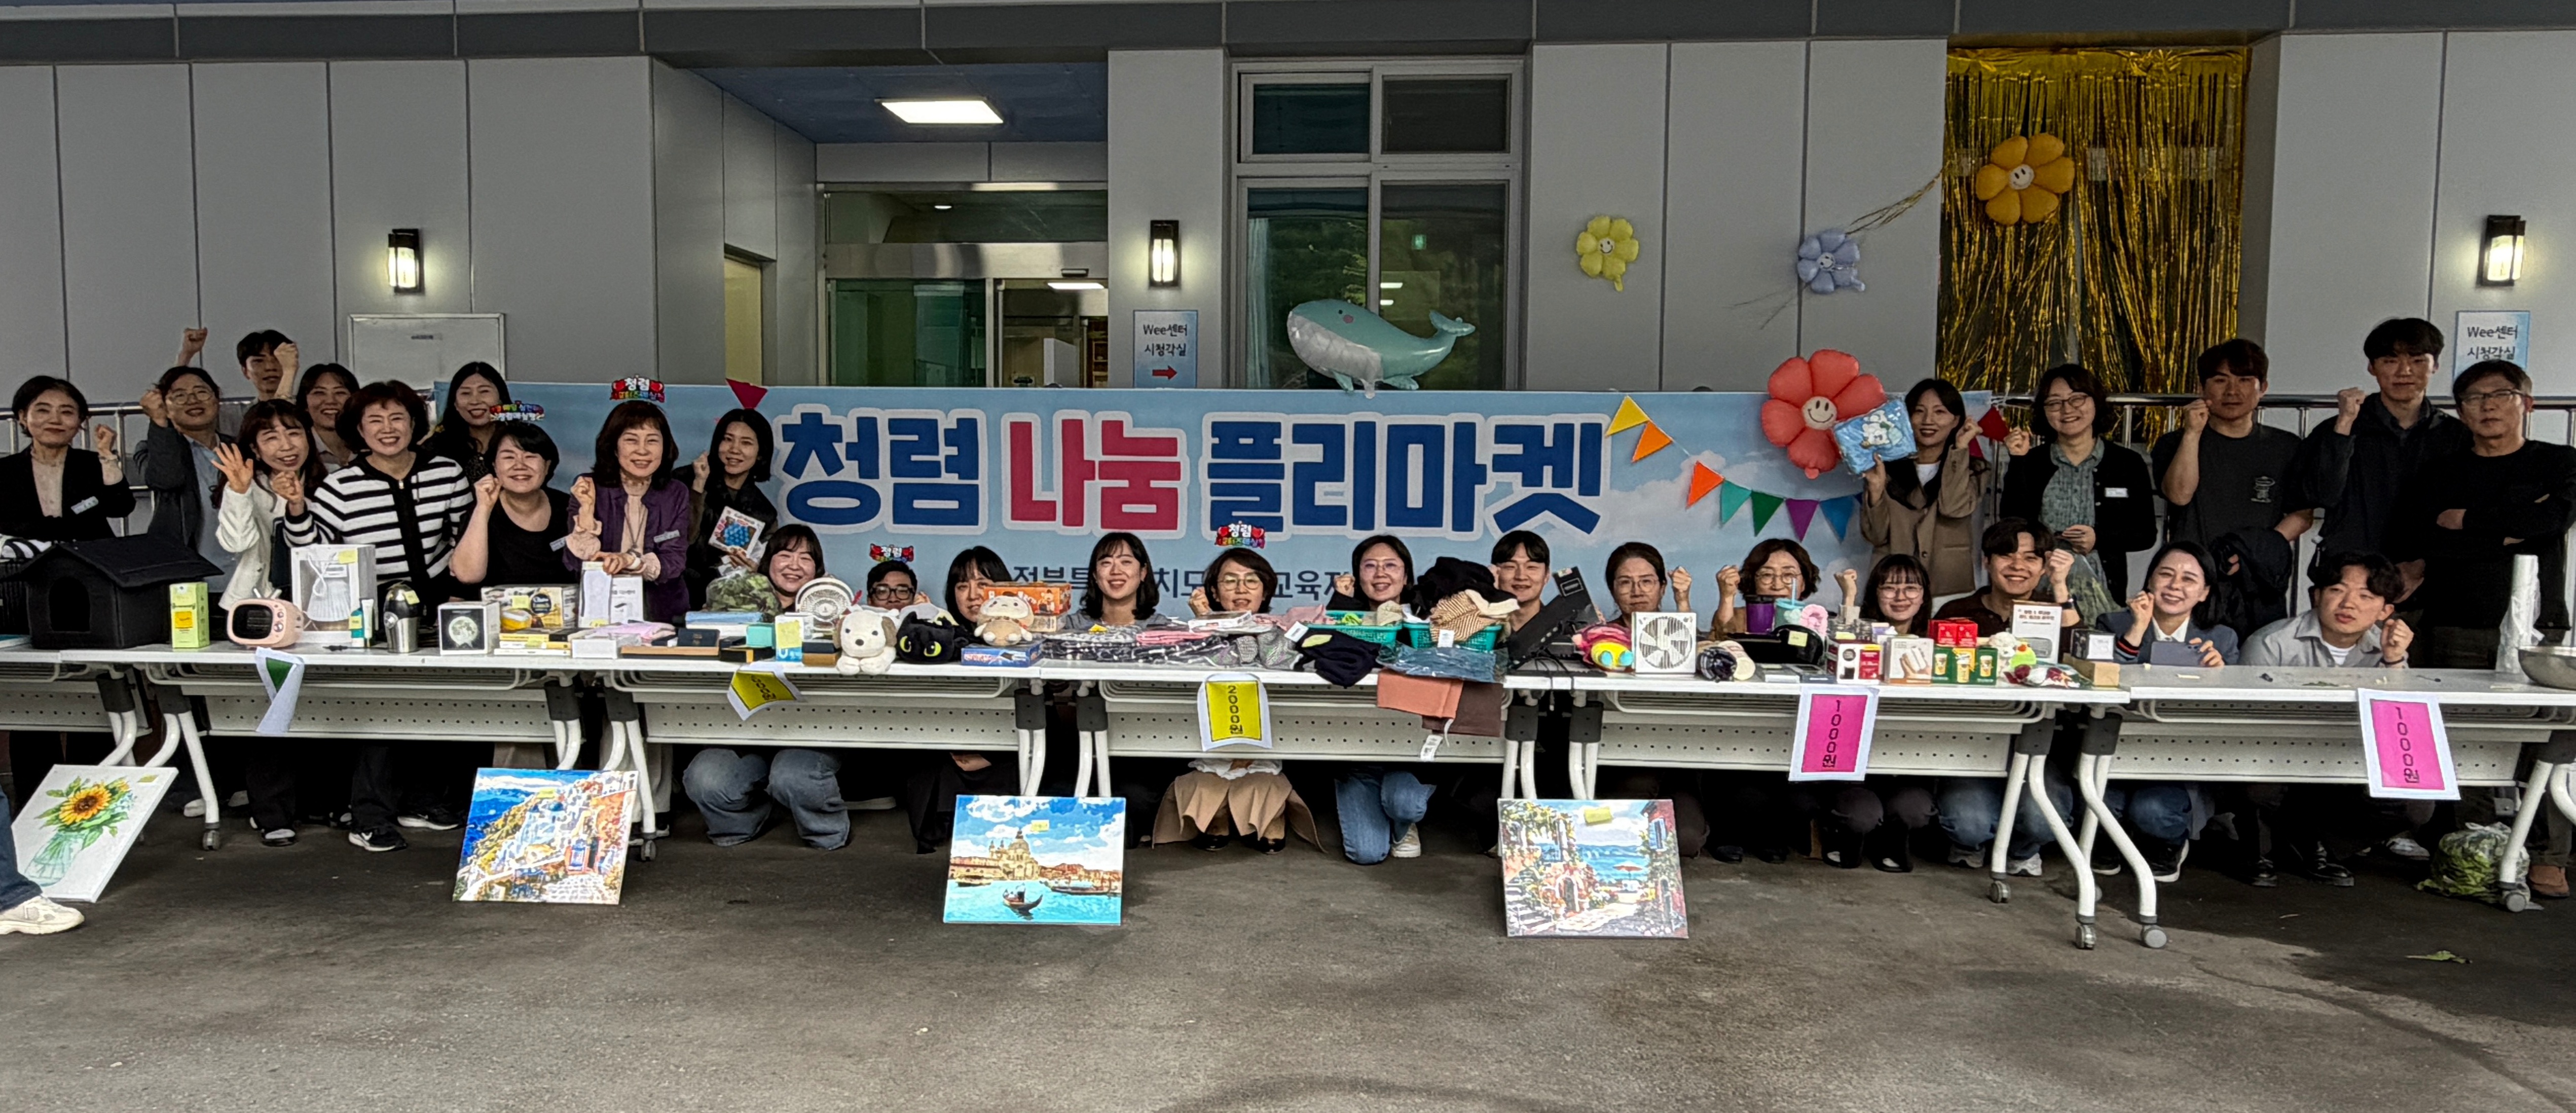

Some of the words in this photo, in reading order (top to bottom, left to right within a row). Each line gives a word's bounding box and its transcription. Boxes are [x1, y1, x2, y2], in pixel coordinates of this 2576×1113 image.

[1143, 323, 1188, 337] Wee센터
[2467, 324, 2518, 339] Wee센터
[1144, 343, 1186, 356] 시청각실
[2467, 346, 2515, 360] 시청각실
[624, 377, 650, 391] 청렴
[782, 412, 980, 526] 청렴
[1009, 419, 1182, 531] 나눔
[1207, 421, 1602, 534] 플리마켓
[1228, 524, 1252, 537] 청렴
[1228, 685, 1243, 734] 2000원
[1822, 699, 1842, 767] 1000원
[2395, 706, 2420, 783] 1000원
